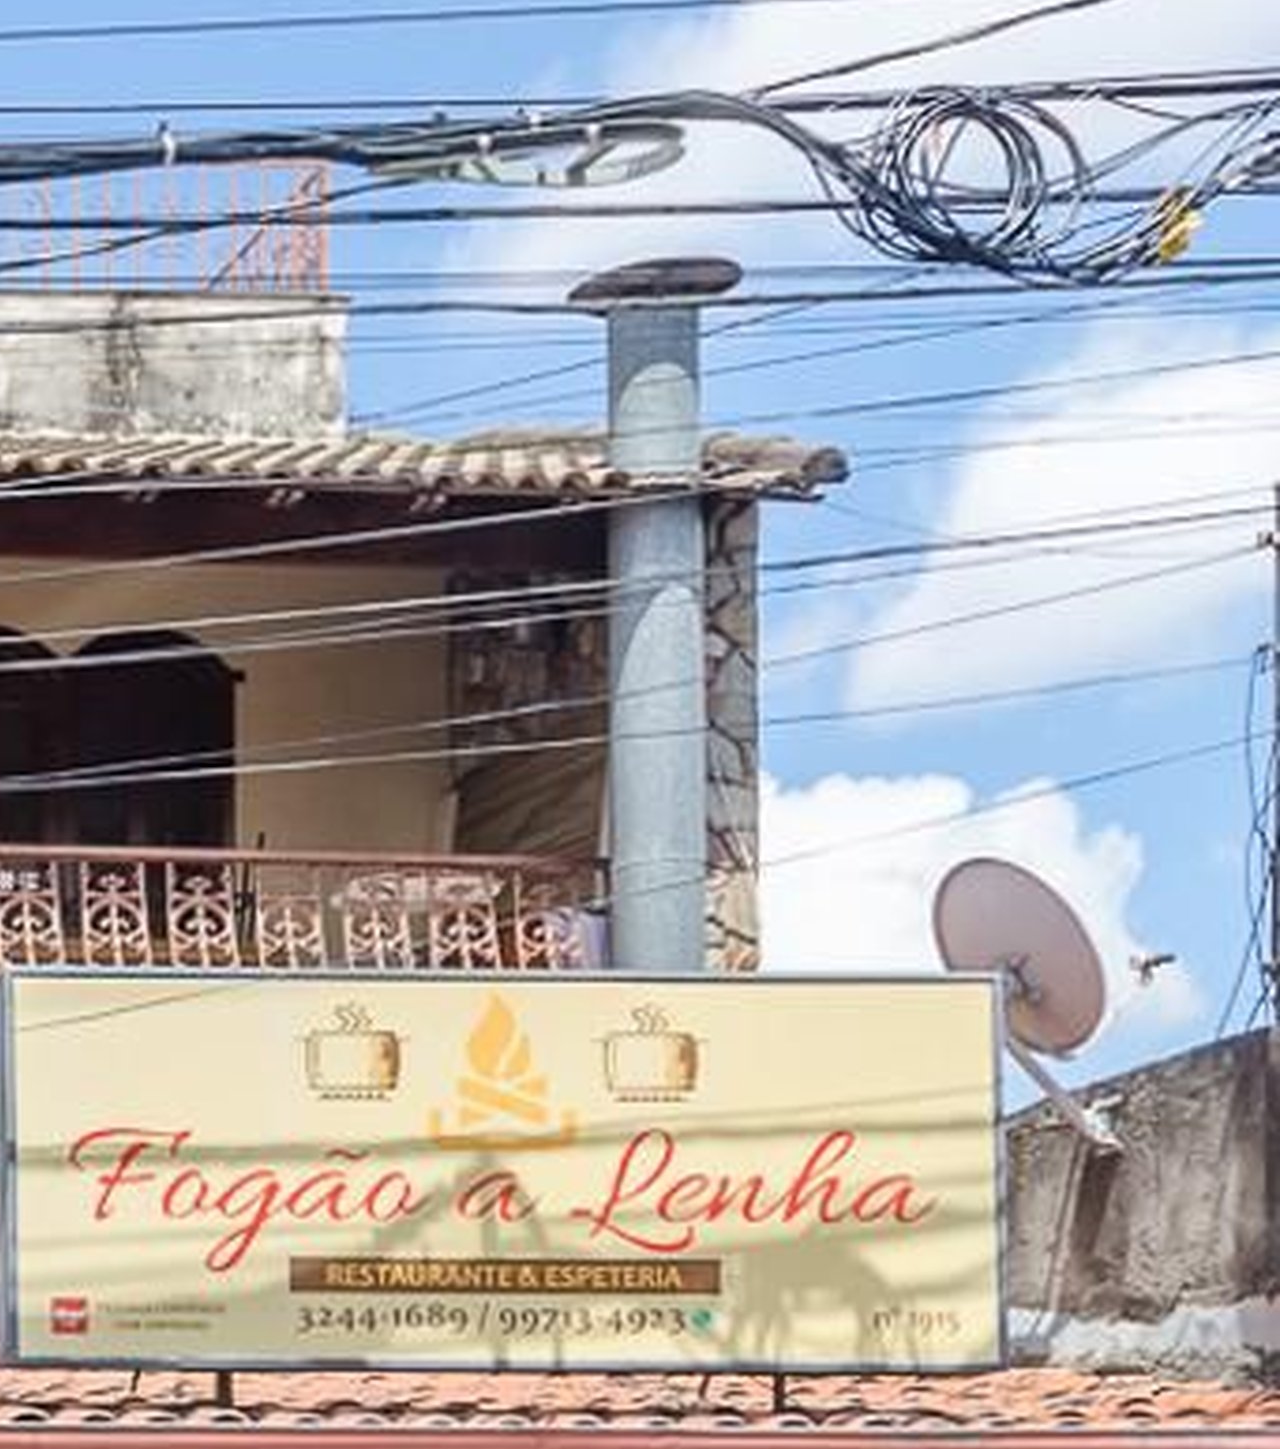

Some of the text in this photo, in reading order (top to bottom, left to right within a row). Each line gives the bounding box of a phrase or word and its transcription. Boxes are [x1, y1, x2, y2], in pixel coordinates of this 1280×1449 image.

[69, 1127, 939, 1273] Fogão a Lenha
[325, 1262, 682, 1289] RESTAURANTE & ESPETERIA
[296, 1302, 470, 1335] 3244-1689
[497, 1303, 687, 1336] 99713-4923
